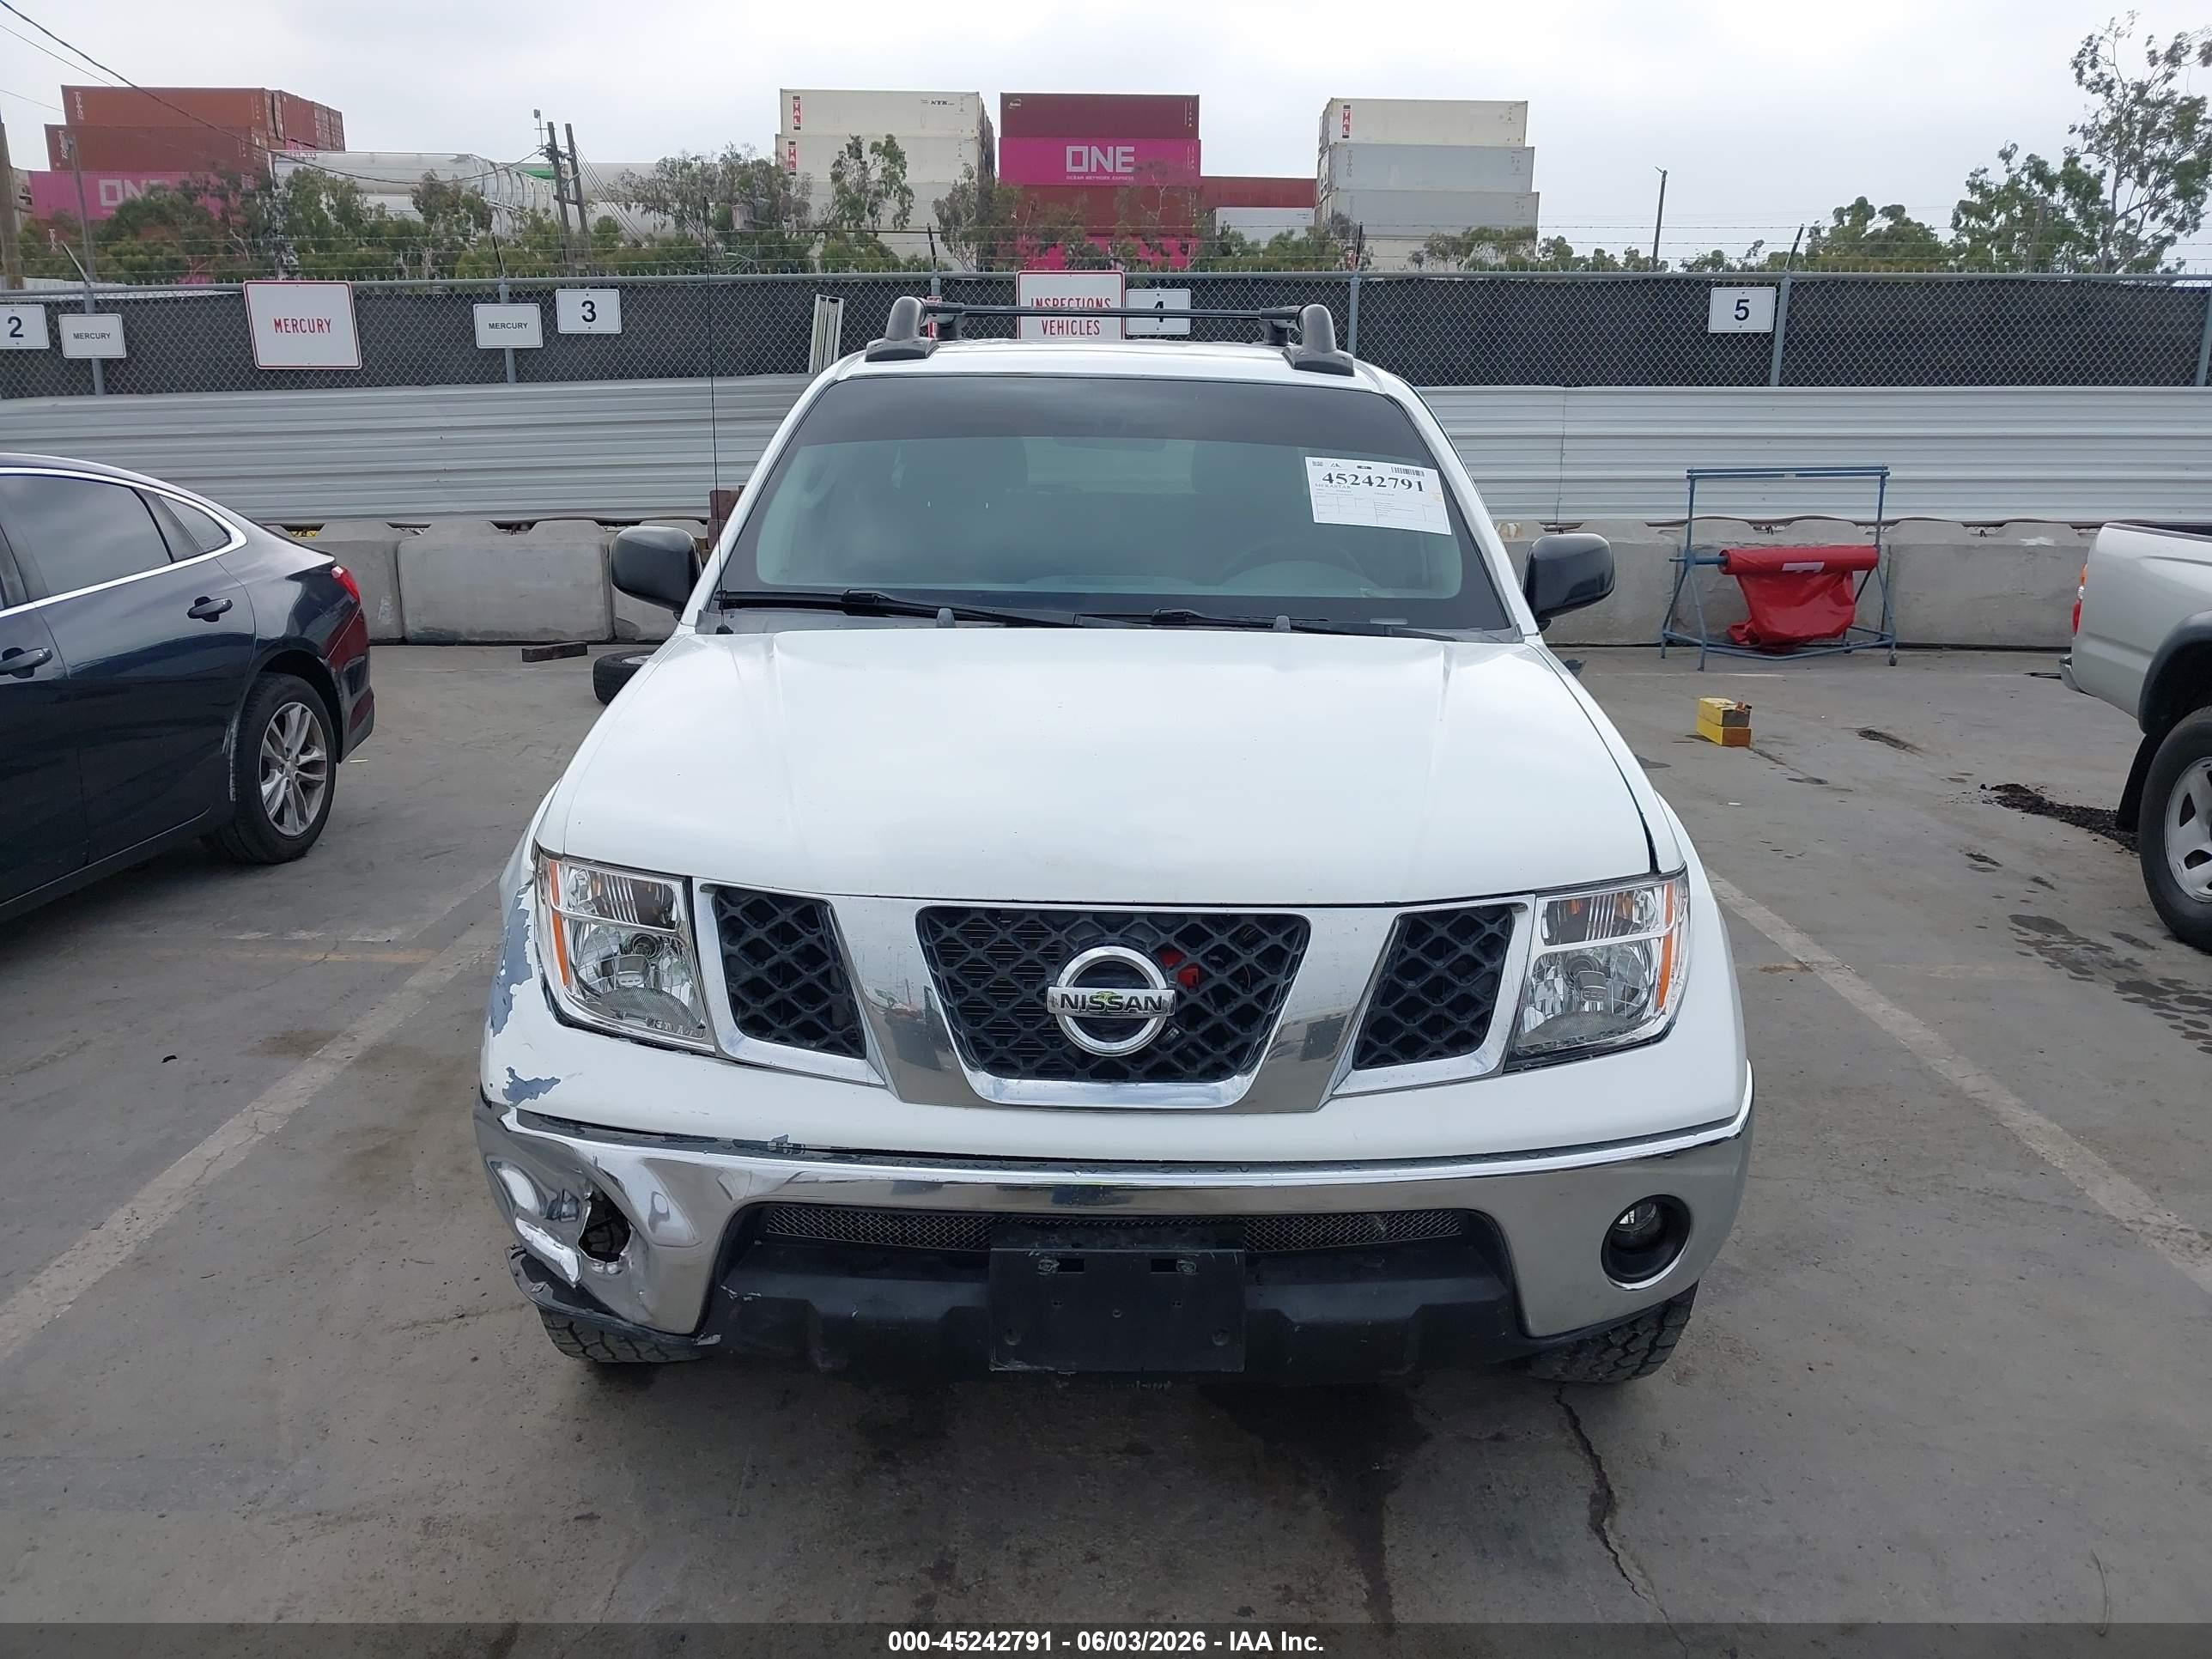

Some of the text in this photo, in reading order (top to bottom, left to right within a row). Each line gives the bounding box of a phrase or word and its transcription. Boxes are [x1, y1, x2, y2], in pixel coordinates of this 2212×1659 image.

[1066, 146, 1134, 173] ONE
[581, 300, 597, 323] 3
[1030, 297, 1111, 308] INSPECTIONS
[1153, 301, 1165, 323] 4
[1734, 298, 1750, 321] 5
[7, 315, 24, 338] 2
[273, 318, 331, 334] MERCURY
[1041, 319, 1100, 336] VEHICLES
[1322, 471, 1425, 493] 45242791
[1060, 994, 1163, 1012] NISSAN
